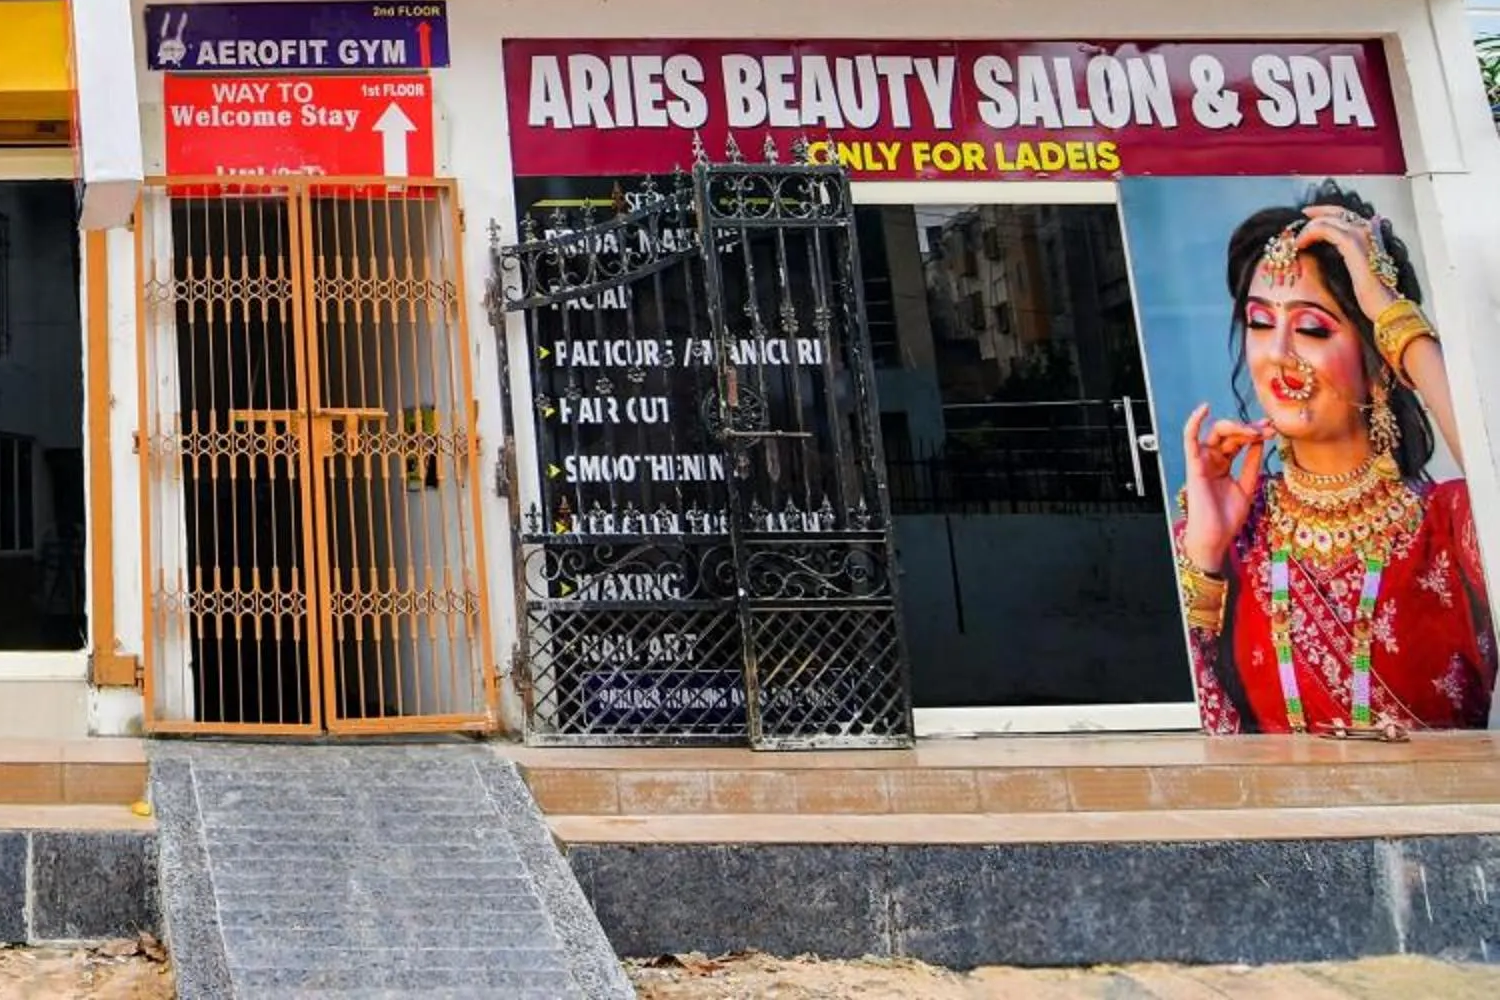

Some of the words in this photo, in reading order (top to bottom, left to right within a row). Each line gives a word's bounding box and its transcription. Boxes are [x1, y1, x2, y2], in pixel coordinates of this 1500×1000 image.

[373, 6, 395, 17] 2nd
[398, 6, 441, 17] FLOOR
[196, 39, 329, 66] AEROFIT
[338, 39, 406, 65] GYM
[211, 83, 270, 104] WAY
[277, 83, 313, 103] TO
[361, 84, 380, 97] 1st
[383, 84, 424, 97] FLOOR
[528, 55, 708, 129] ARIES
[722, 55, 956, 129] BEAUTY
[974, 54, 1176, 130] SALON
[1192, 54, 1243, 127] &
[1259, 53, 1376, 129] SPA
[171, 105, 292, 127] Welcome
[300, 104, 361, 131] Stay
[808, 142, 900, 171] ONLY
[913, 142, 986, 171] FOR
[995, 142, 1119, 171] LADEIS
